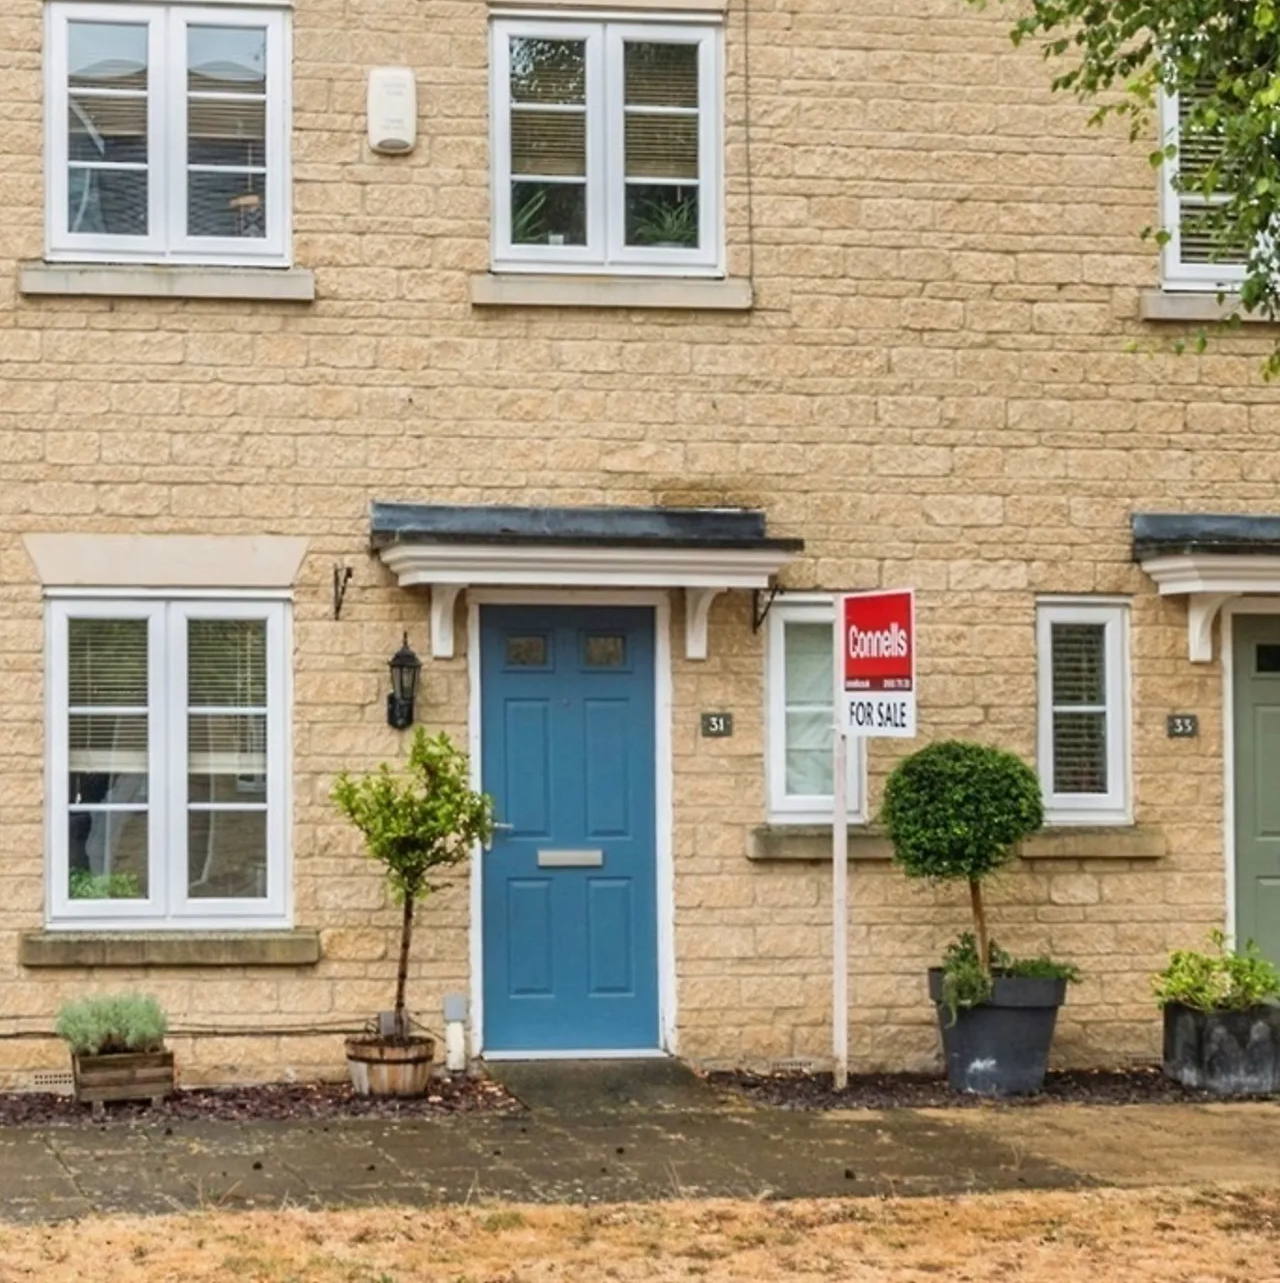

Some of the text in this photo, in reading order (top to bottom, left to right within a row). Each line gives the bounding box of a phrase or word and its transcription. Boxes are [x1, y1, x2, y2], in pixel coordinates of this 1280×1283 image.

[849, 622, 908, 659] Connells
[709, 716, 724, 732] 31
[850, 701, 907, 728] FOR SALE
[1174, 718, 1193, 733] 33
